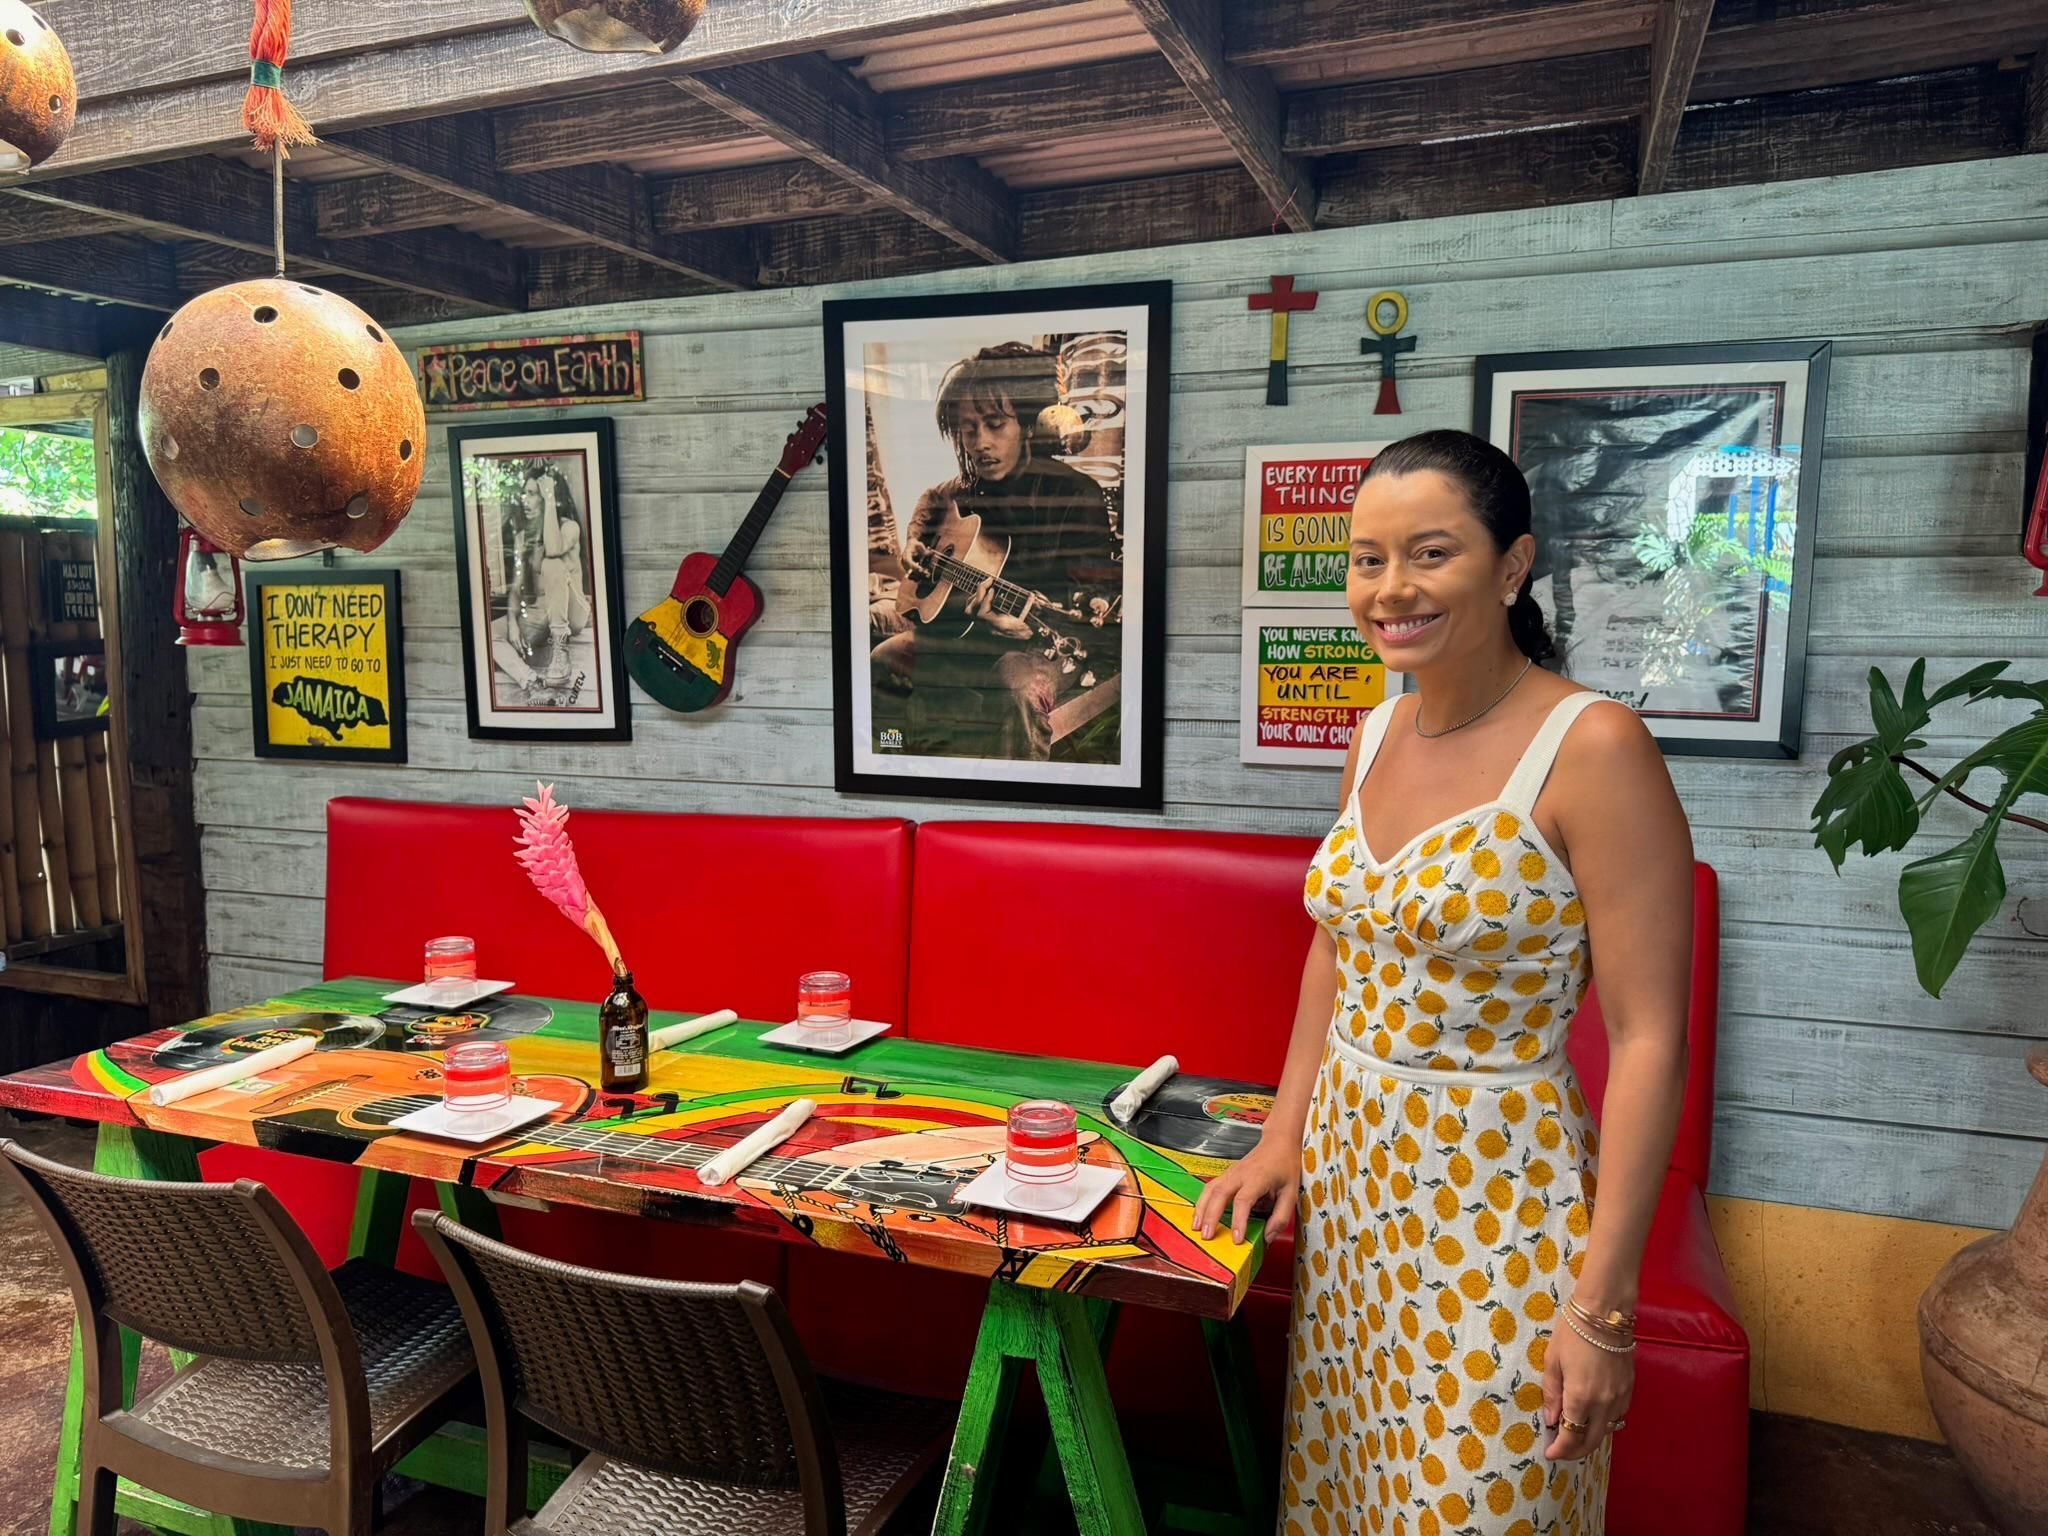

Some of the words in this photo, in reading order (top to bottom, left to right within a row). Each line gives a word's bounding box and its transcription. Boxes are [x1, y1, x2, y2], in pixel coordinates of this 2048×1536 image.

[449, 353, 519, 400] Peace
[521, 360, 550, 385] on
[553, 343, 630, 394] Earth
[1265, 464, 1318, 486] EVERY
[1275, 484, 1356, 506] THING
[1267, 515, 1284, 542] IS
[1263, 552, 1287, 587] BE
[266, 594, 280, 621] I
[285, 592, 327, 619] DON'T
[332, 594, 383, 618] NEED
[273, 621, 376, 652] THERAPY
[1262, 628, 1288, 642] YOU
[1293, 628, 1337, 642] NEVER
[1267, 644, 1301, 660] HOW
[1304, 644, 1374, 660] STRONG
[270, 655, 277, 669] I
[280, 656, 302, 669] JUST
[304, 655, 332, 670] NEED
[336, 657, 348, 671] TO
[351, 659, 364, 673] GO
[367, 658, 381, 673] TO
[1264, 665, 1301, 682] YOU
[283, 680, 371, 723] JAMAICA
[1277, 683, 1351, 700] UNTIL
[1261, 707, 1350, 724] STRENGTH
[880, 731, 903, 741] BOB
[1260, 721, 1294, 743] YOUR
[1295, 724, 1328, 744] ONLY
